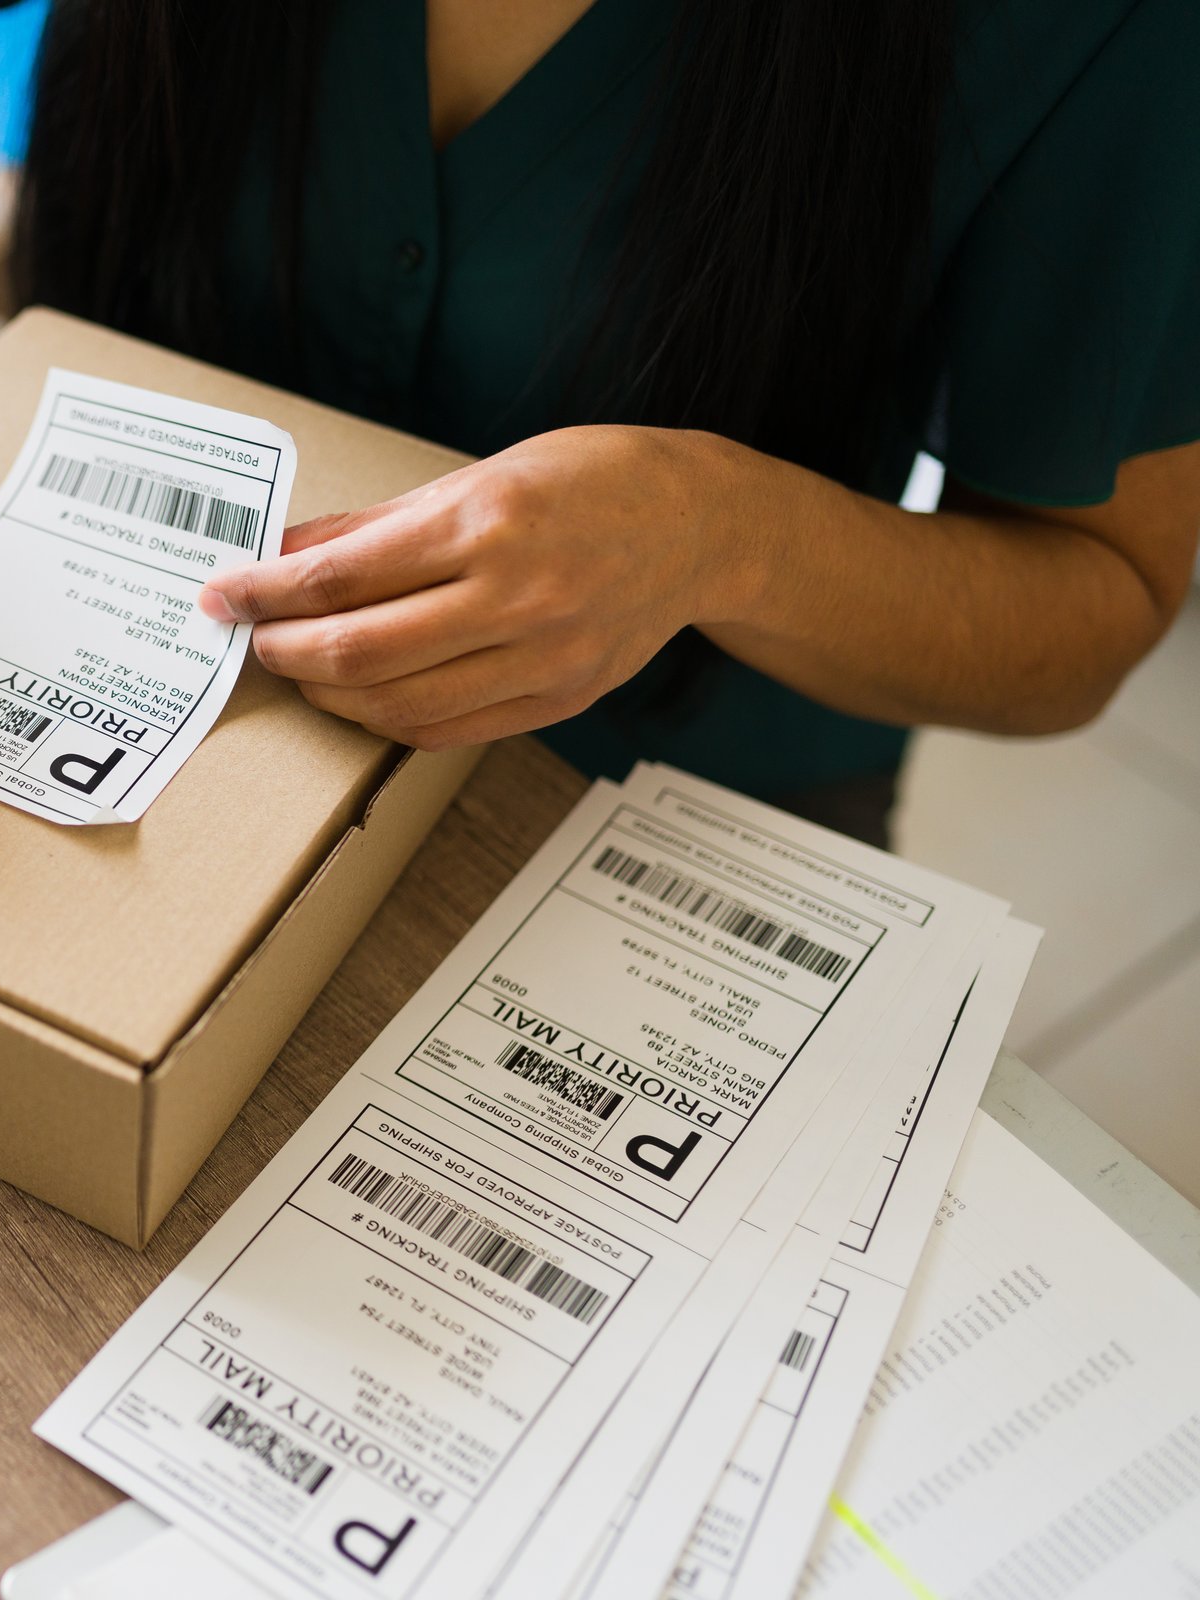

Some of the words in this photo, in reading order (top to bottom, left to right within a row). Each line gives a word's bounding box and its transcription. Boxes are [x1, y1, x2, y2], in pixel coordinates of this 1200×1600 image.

[71, 409, 120, 430] SHIPPING
[123, 423, 146, 437] FOR
[149, 429, 207, 452] APPROVED
[208, 444, 259, 467] POSTAGE
[60, 511, 69, 519] #
[72, 514, 143, 546] TRACKING
[148, 537, 217, 567] SHIPPING
[103, 573, 116, 585] FL
[119, 579, 150, 597] CITY,
[65, 588, 79, 599] 12
[155, 591, 193, 612] SMALL
[82, 596, 133, 620] STREET
[161, 609, 186, 625] USA
[124, 625, 172, 650] MILLER
[134, 616, 179, 638] SHORT
[74, 648, 109, 668] 12345
[175, 644, 216, 666] PAULA
[79, 664, 96, 675] 89
[113, 664, 132, 676] AZ
[58, 668, 108, 694] BROWN
[96, 672, 149, 698] STREET
[135, 671, 166, 691] CITY,
[150, 694, 186, 714] MAIN
[169, 687, 193, 703] BIG
[110, 690, 176, 725] VERONICA
[7, 738, 28, 751] ZONE
[5, 754, 17, 762] US
[49, 747, 127, 795] P
[4, 775, 46, 796] Global
[695, 849, 721, 866] FOR
[724, 864, 794, 900] APPROVED
[845, 879, 907, 910] POSTAGE
[630, 901, 706, 943] TRACKING
[798, 898, 860, 930] POSTAGE
[626, 965, 640, 977] 12
[664, 957, 677, 969] FL
[711, 940, 788, 980] SHIPPING
[491, 974, 528, 997] 0008
[646, 975, 697, 1003] STREET
[719, 984, 760, 1008] SMALL
[700, 1001, 747, 1027] SHORT
[727, 1000, 753, 1018] USA
[492, 997, 561, 1045] MAIL
[689, 1009, 735, 1033] JONES
[641, 1023, 677, 1046] 12345
[647, 1040, 663, 1052] 89
[681, 1044, 701, 1056] AZ
[738, 1032, 787, 1060] PEDRO
[463, 1054, 485, 1068] FROM
[656, 1056, 707, 1087] GARCIA
[665, 1050, 720, 1080] STREET
[704, 1053, 737, 1075] CITY,
[563, 1041, 723, 1128] PRIORITY
[722, 1077, 759, 1099] MAIN
[740, 1073, 766, 1090] BIG
[503, 1092, 521, 1104] PAID
[519, 1101, 540, 1114] FEES
[539, 1094, 557, 1106] RATE
[710, 1084, 752, 1110] MARK
[464, 1093, 521, 1128] Company
[546, 1105, 563, 1117] MAIL
[556, 1103, 575, 1115] FLAT
[545, 1114, 581, 1135] POSTAGE
[561, 1114, 597, 1135] PRIORITY
[579, 1115, 602, 1129] ZONE
[378, 1122, 443, 1162] SHIPPING
[524, 1124, 579, 1159] Shipping
[579, 1132, 592, 1141] US
[625, 1130, 703, 1182] P
[444, 1158, 475, 1179] FOR
[581, 1155, 624, 1182] Global
[476, 1176, 554, 1220] APPROVED
[350, 1212, 364, 1223] #
[365, 1219, 449, 1273] TRACKING
[553, 1216, 622, 1259] POSTAGE
[364, 1274, 404, 1300] 12487
[453, 1268, 536, 1320] SHIPPING
[359, 1302, 383, 1322] 754
[410, 1296, 426, 1313] FL
[202, 1311, 241, 1338] 0008
[385, 1319, 442, 1355] STREET
[463, 1345, 492, 1365] USA
[199, 1340, 272, 1399] MAIL
[275, 1395, 445, 1509] PRIORITY
[333, 1517, 416, 1575] P
